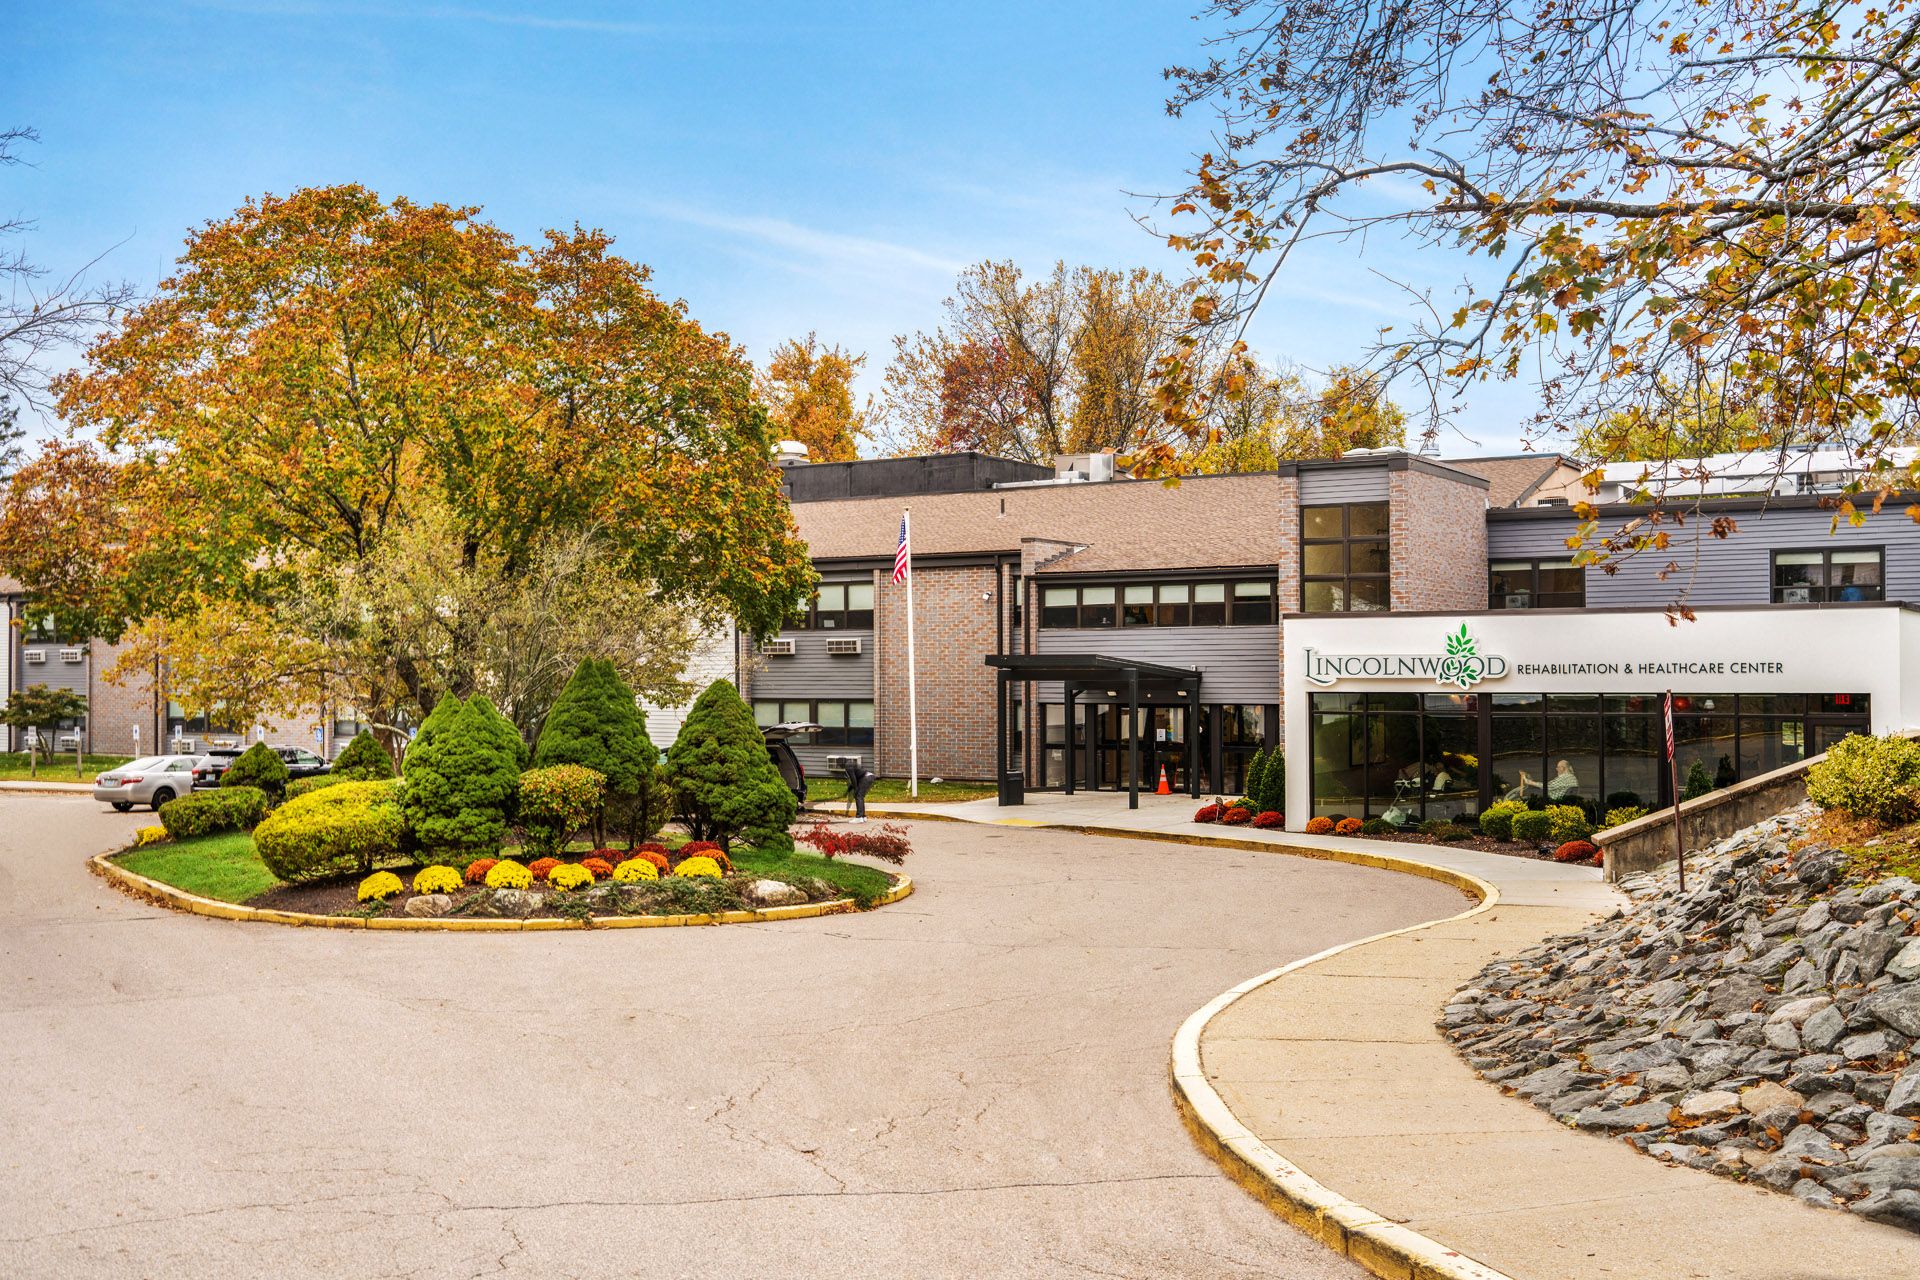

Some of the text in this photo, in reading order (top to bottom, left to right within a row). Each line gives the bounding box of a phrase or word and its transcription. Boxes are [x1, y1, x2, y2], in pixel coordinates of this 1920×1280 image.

[1305, 649, 1506, 684] LINCOLNWOOD
[1517, 662, 1783, 675] REHABILITATION & HEALTHCARE CENTER
